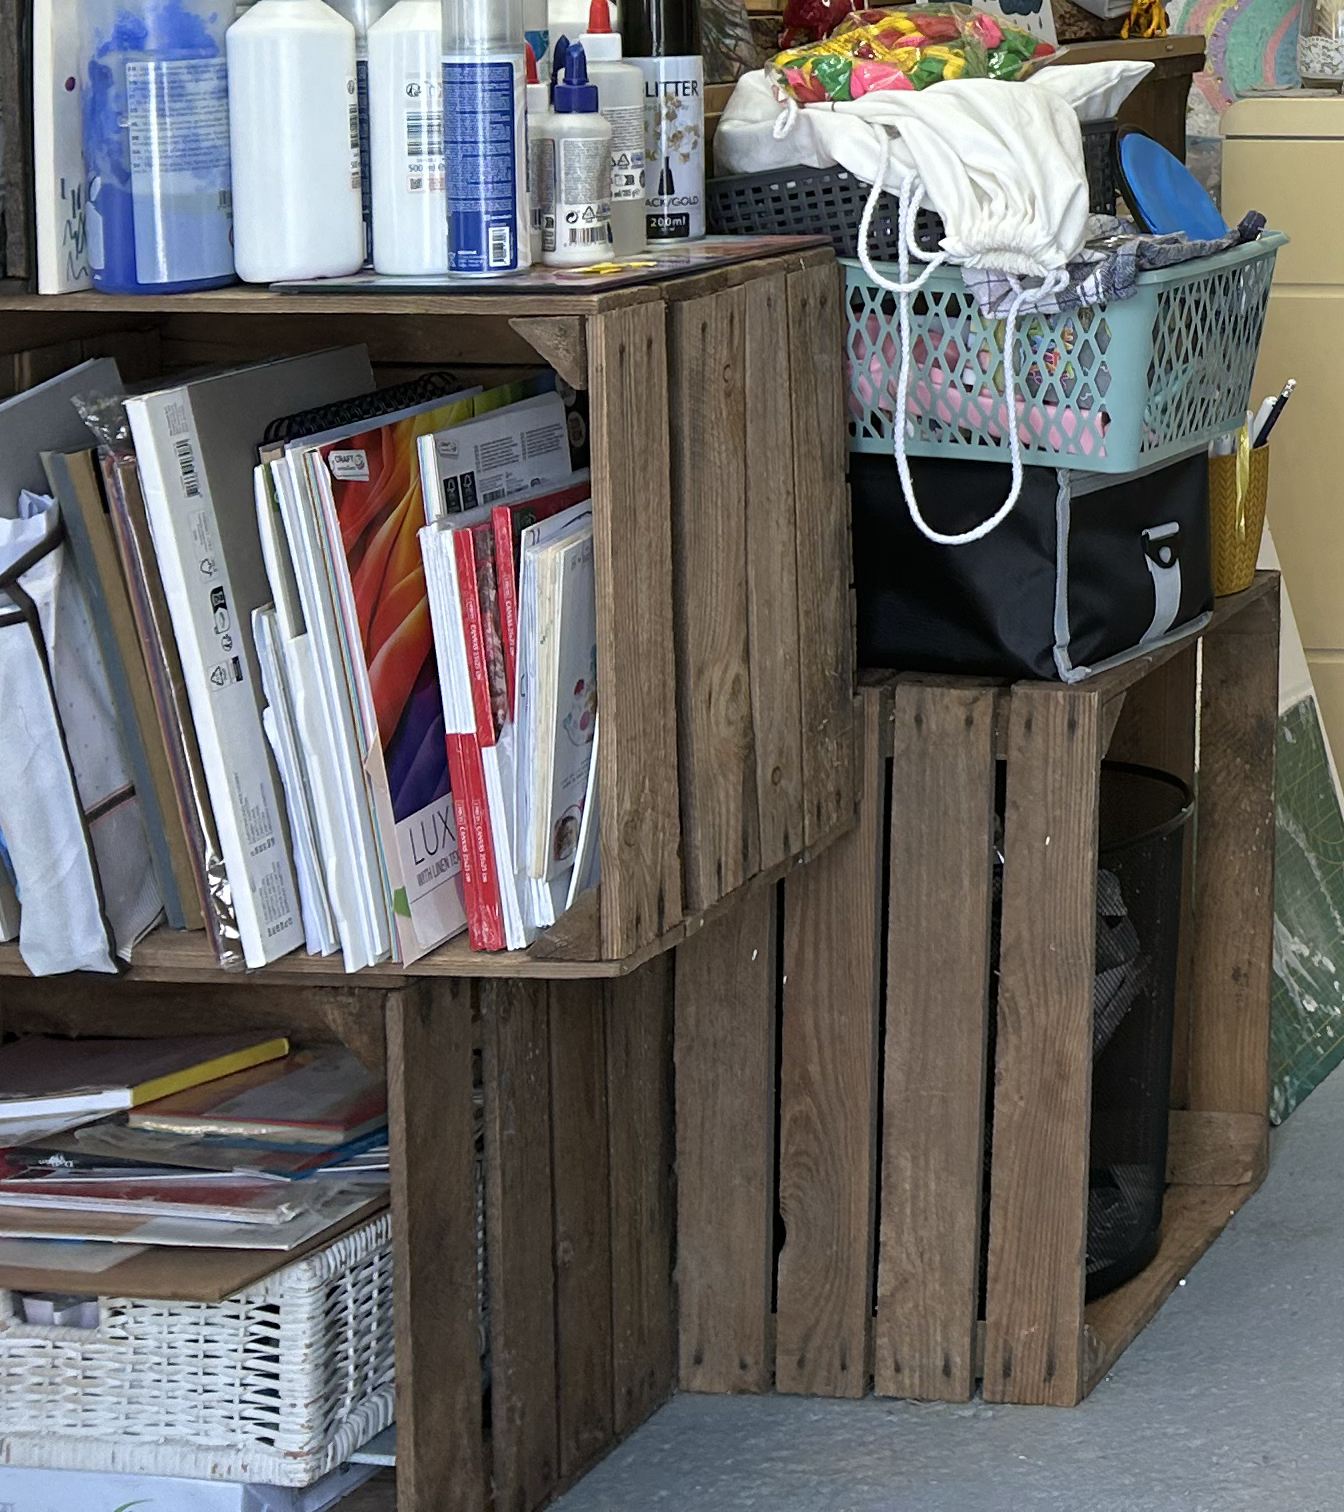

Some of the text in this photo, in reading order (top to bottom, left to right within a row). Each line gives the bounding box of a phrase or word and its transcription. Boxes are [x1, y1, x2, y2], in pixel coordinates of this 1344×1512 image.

[644, 80, 699, 98] LITTER
[645, 196, 699, 208] ACK/GOLD
[650, 216, 686, 228] 200ml
